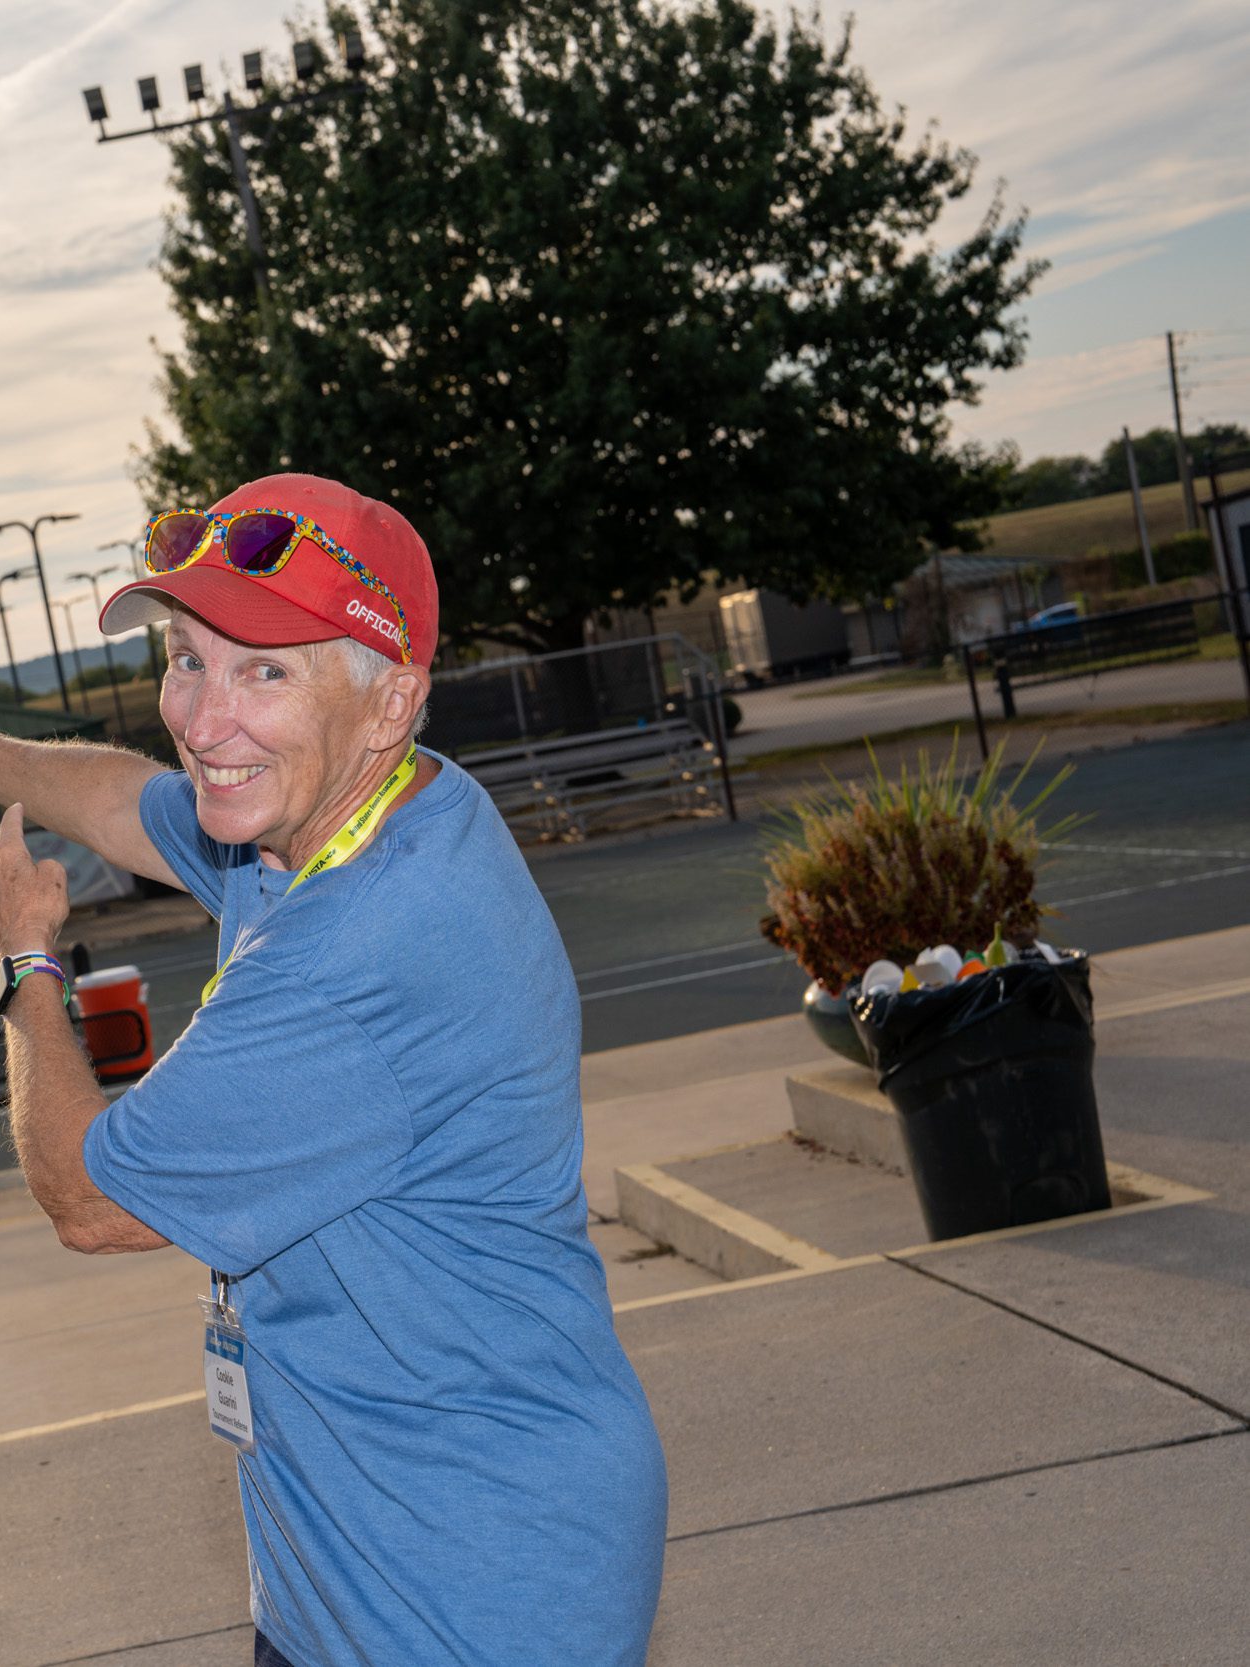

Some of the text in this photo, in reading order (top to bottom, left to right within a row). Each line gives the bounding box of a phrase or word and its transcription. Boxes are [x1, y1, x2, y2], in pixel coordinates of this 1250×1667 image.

[346, 599, 403, 648] OFFICIAL
[348, 774, 399, 836] United States Tennis Association
[216, 1367, 234, 1386] Cookie
